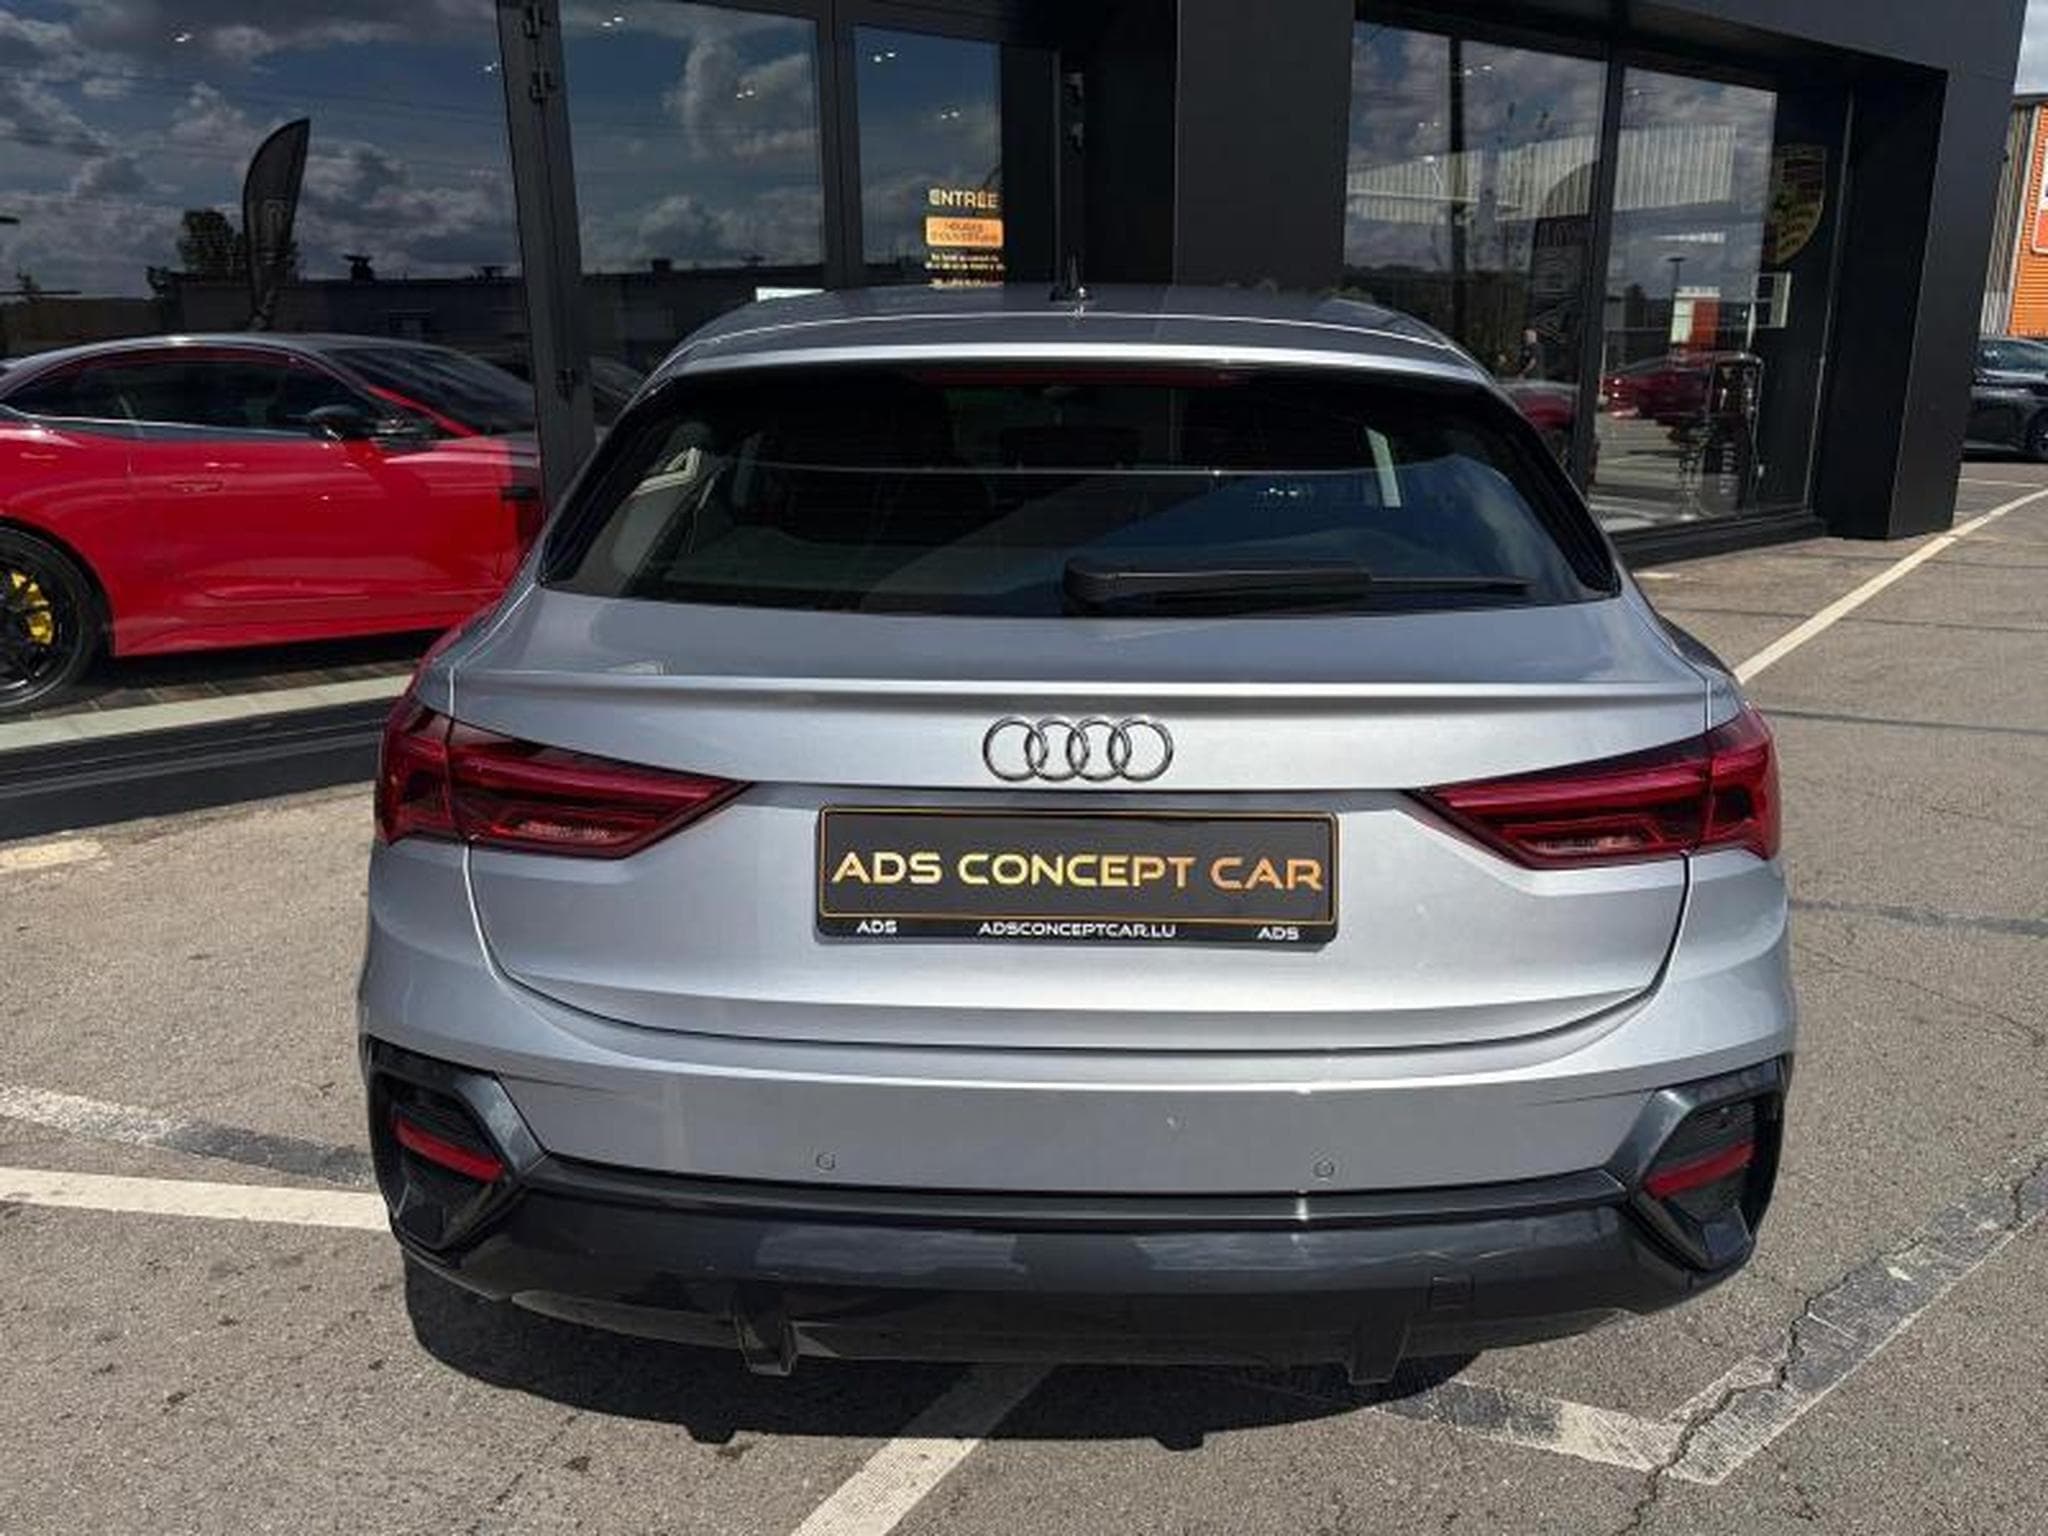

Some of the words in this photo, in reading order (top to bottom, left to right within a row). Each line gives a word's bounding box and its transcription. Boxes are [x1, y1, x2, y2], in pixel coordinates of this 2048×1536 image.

[832, 852, 943, 884] ADS
[958, 853, 1197, 888] CONCEPT
[1210, 856, 1324, 890] CAR
[856, 920, 898, 935] ADS
[979, 922, 1177, 938] ADSCONCEPTCAR.LU
[1257, 926, 1301, 941] ADS
